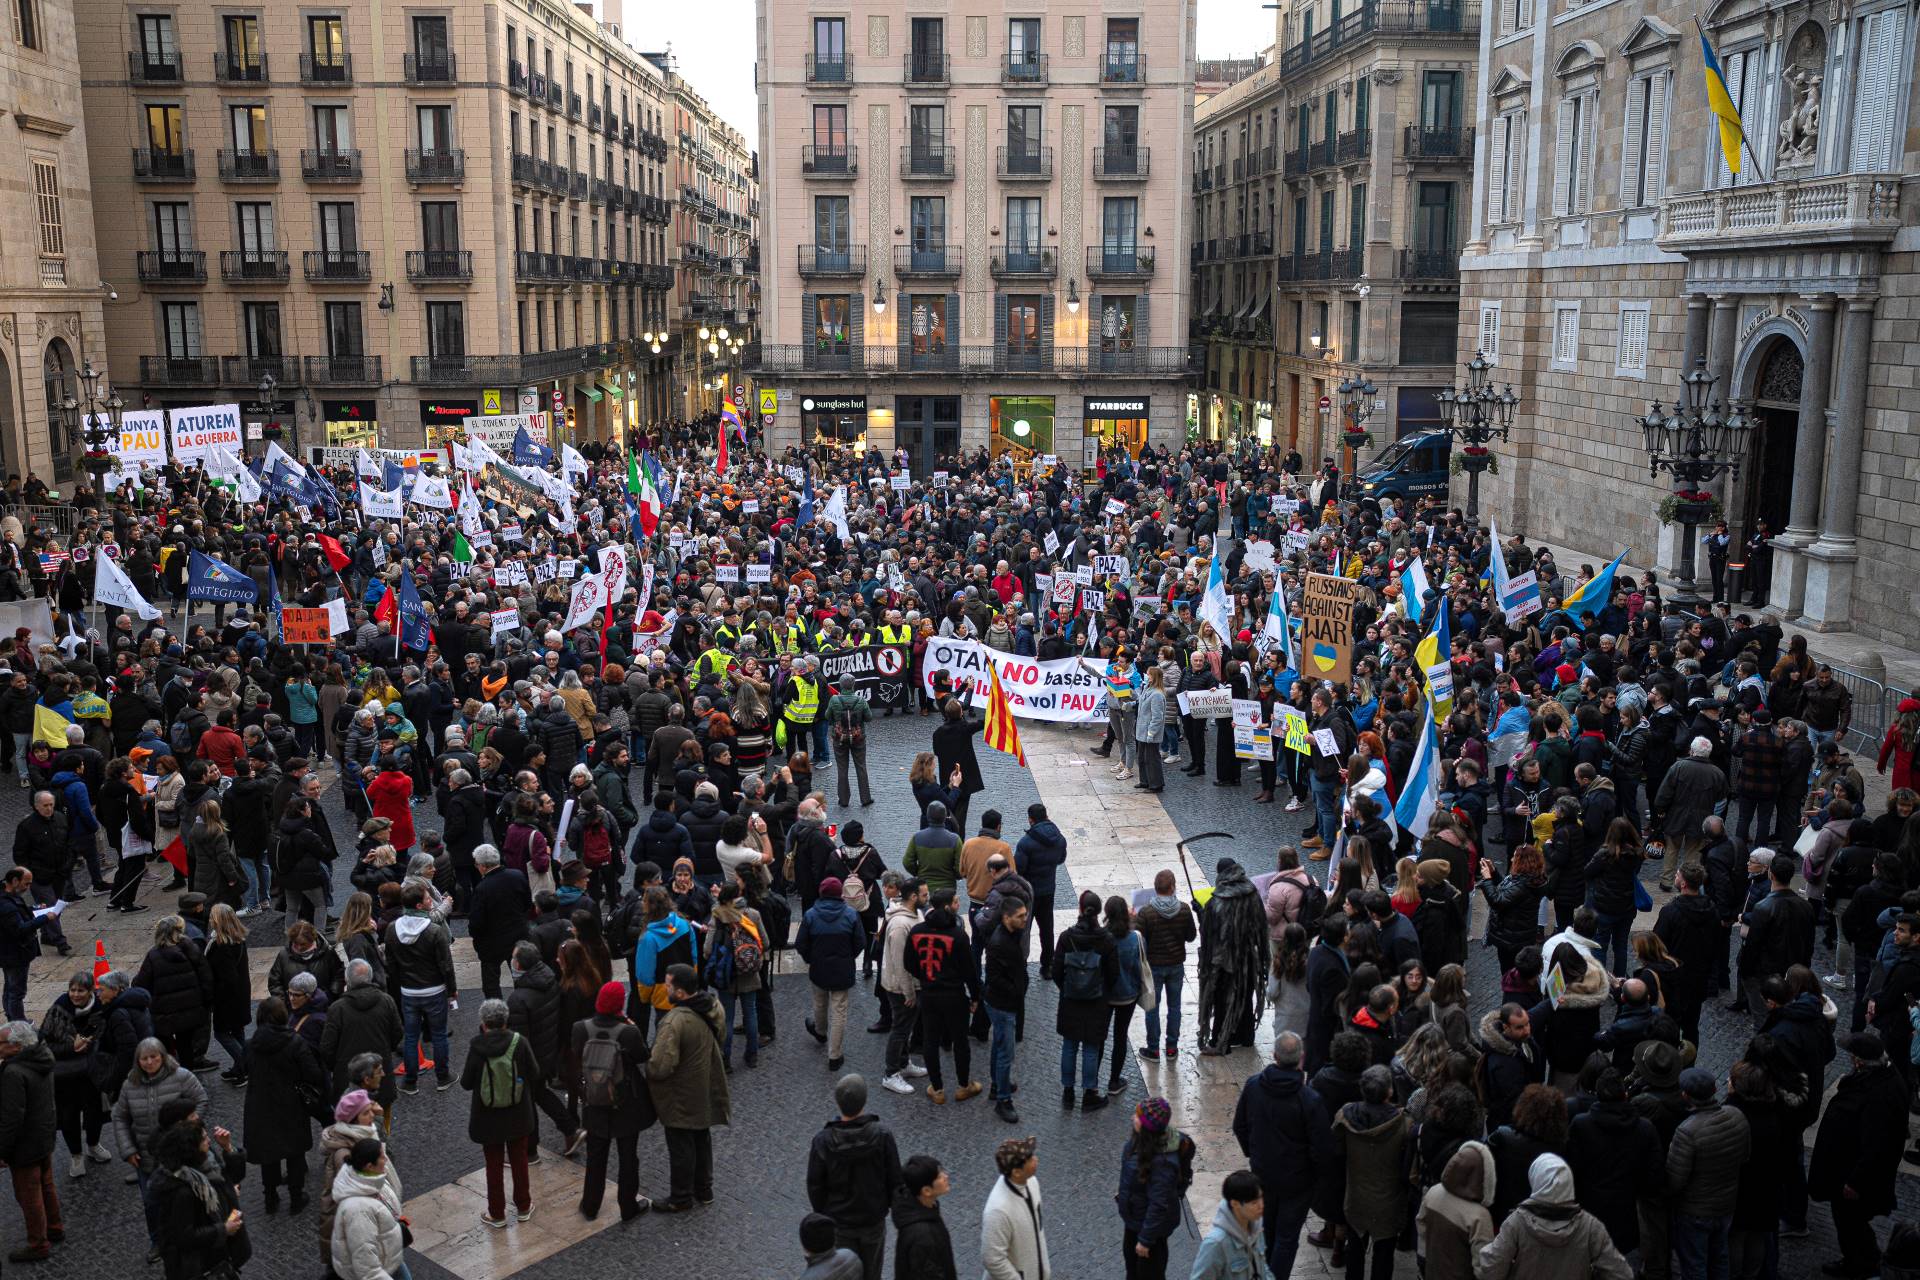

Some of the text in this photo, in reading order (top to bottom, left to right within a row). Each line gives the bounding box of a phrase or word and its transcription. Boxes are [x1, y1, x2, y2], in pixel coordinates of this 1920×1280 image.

[1786, 308, 1809, 336] GENERAL
[816, 399, 865, 411] sunglass hut
[1089, 402, 1144, 411] STARBUCKS
[97, 419, 159, 435] ATLUNYA
[177, 413, 236, 433] ATUREM
[529, 414, 545, 429] NO
[122, 431, 160, 451] PAU
[178, 436, 192, 448] LA
[195, 430, 238, 446] GUERRA
[322, 449, 359, 459] ERECHO
[1280, 535, 1295, 549] PAZ
[450, 561, 469, 579] PAZ
[507, 560, 525, 576] PAZ
[538, 563, 552, 579] PAZ
[1099, 556, 1116, 573] PAZ
[97, 589, 131, 604] SANT'E
[189, 585, 254, 600] SANT'EGIDIO
[1308, 576, 1355, 600] RUSSIANS
[1086, 590, 1100, 610] PAZ
[1304, 595, 1353, 621] AGAINST
[1304, 617, 1347, 646] WAR
[822, 650, 875, 678] GUERRA
[1002, 661, 1039, 686] NO
[1043, 671, 1092, 687] bases
[927, 670, 1096, 712] Ctluya vol PAU
[79, 704, 107, 713] AINE
[1290, 716, 1304, 736] NO
